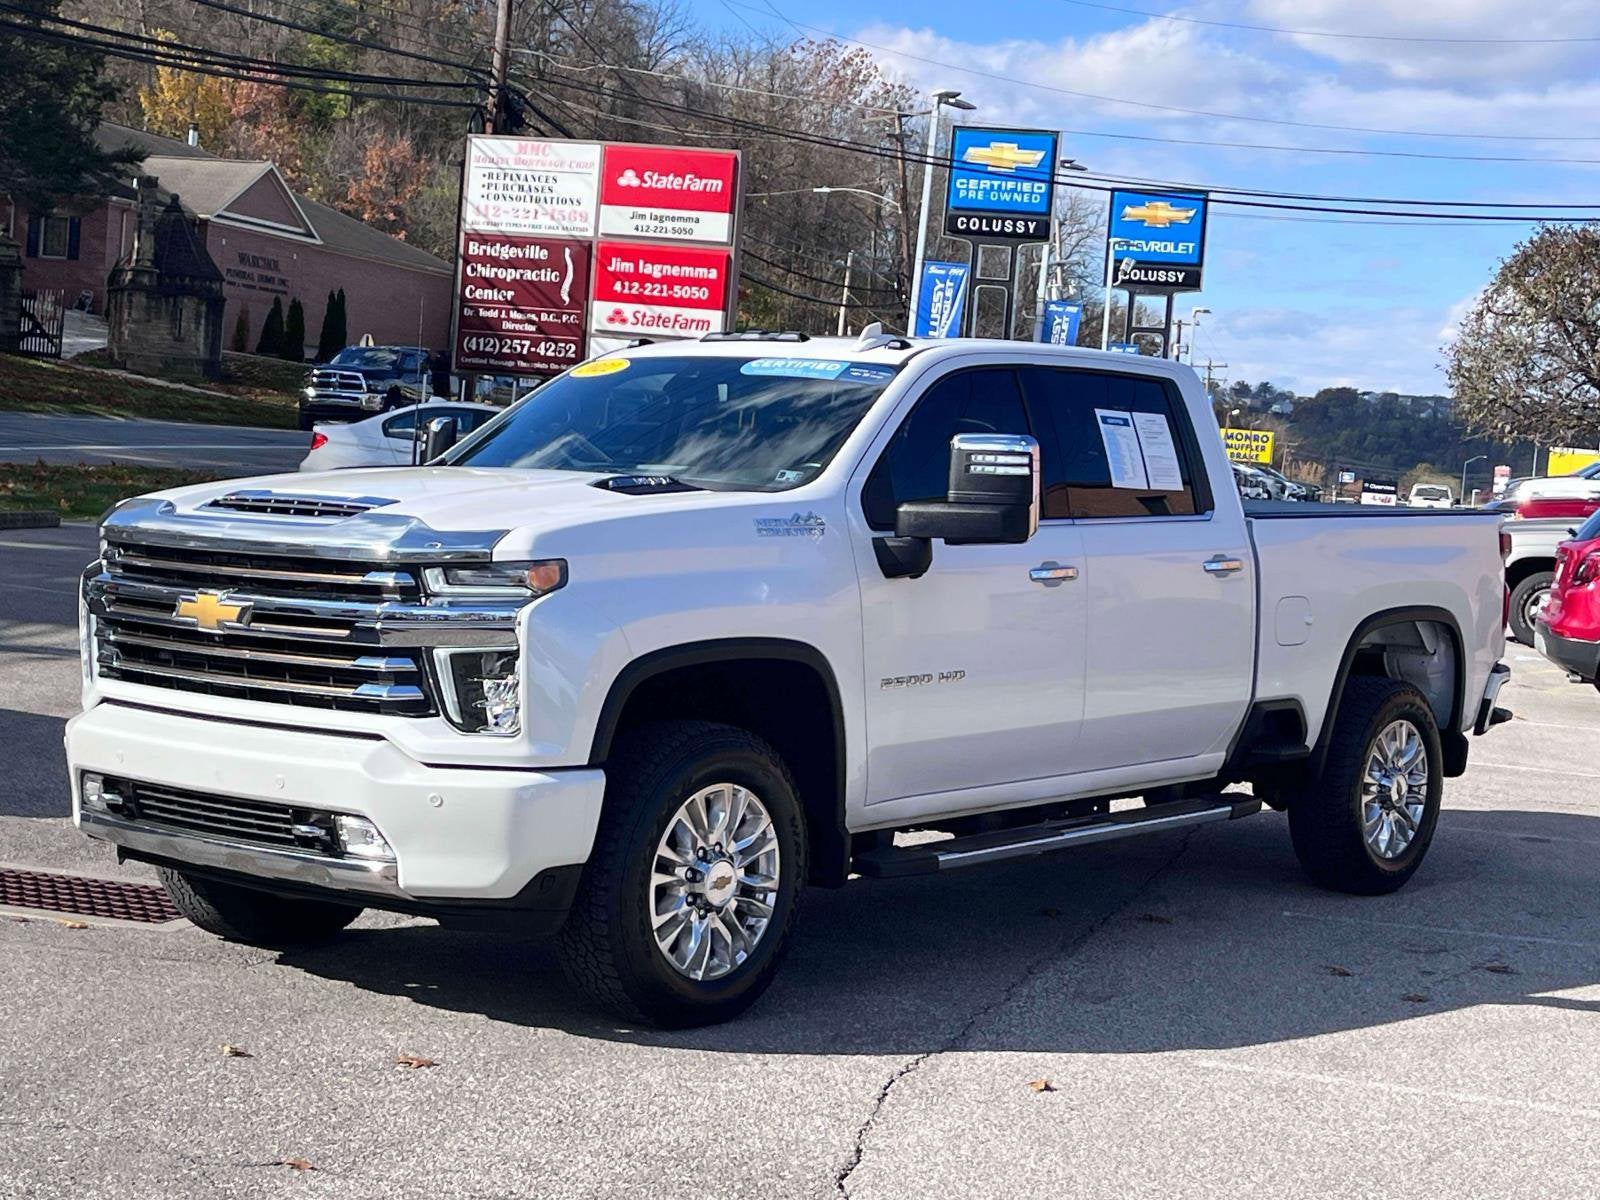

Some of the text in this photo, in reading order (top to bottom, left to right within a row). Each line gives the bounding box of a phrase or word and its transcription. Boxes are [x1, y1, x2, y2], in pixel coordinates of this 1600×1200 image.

[515, 142, 552, 157] MMC
[487, 172, 558, 184] REFINANCES
[955, 178, 1046, 193] CERTIFIED
[486, 183, 554, 194] PURCHASES
[486, 193, 582, 206] CONSOLIDATIONS
[630, 211, 647, 221] Jim
[633, 224, 694, 236] 412-221-5050
[956, 216, 1037, 234] COLUSSY
[467, 240, 549, 260] Bridgeville
[466, 263, 560, 282] Chiropractic
[607, 256, 718, 280] Jim Iagnemma
[464, 284, 515, 301] Center
[613, 280, 709, 300] 412-221-5050
[479, 308, 498, 318] Todd
[500, 309, 508, 319] J.
[502, 320, 538, 332] Director
[463, 336, 576, 358] (412) 257-4252
[750, 358, 842, 371] CERTIFIED
[1224, 432, 1270, 444] MONRO
[880, 670, 966, 690] 2500 HD
